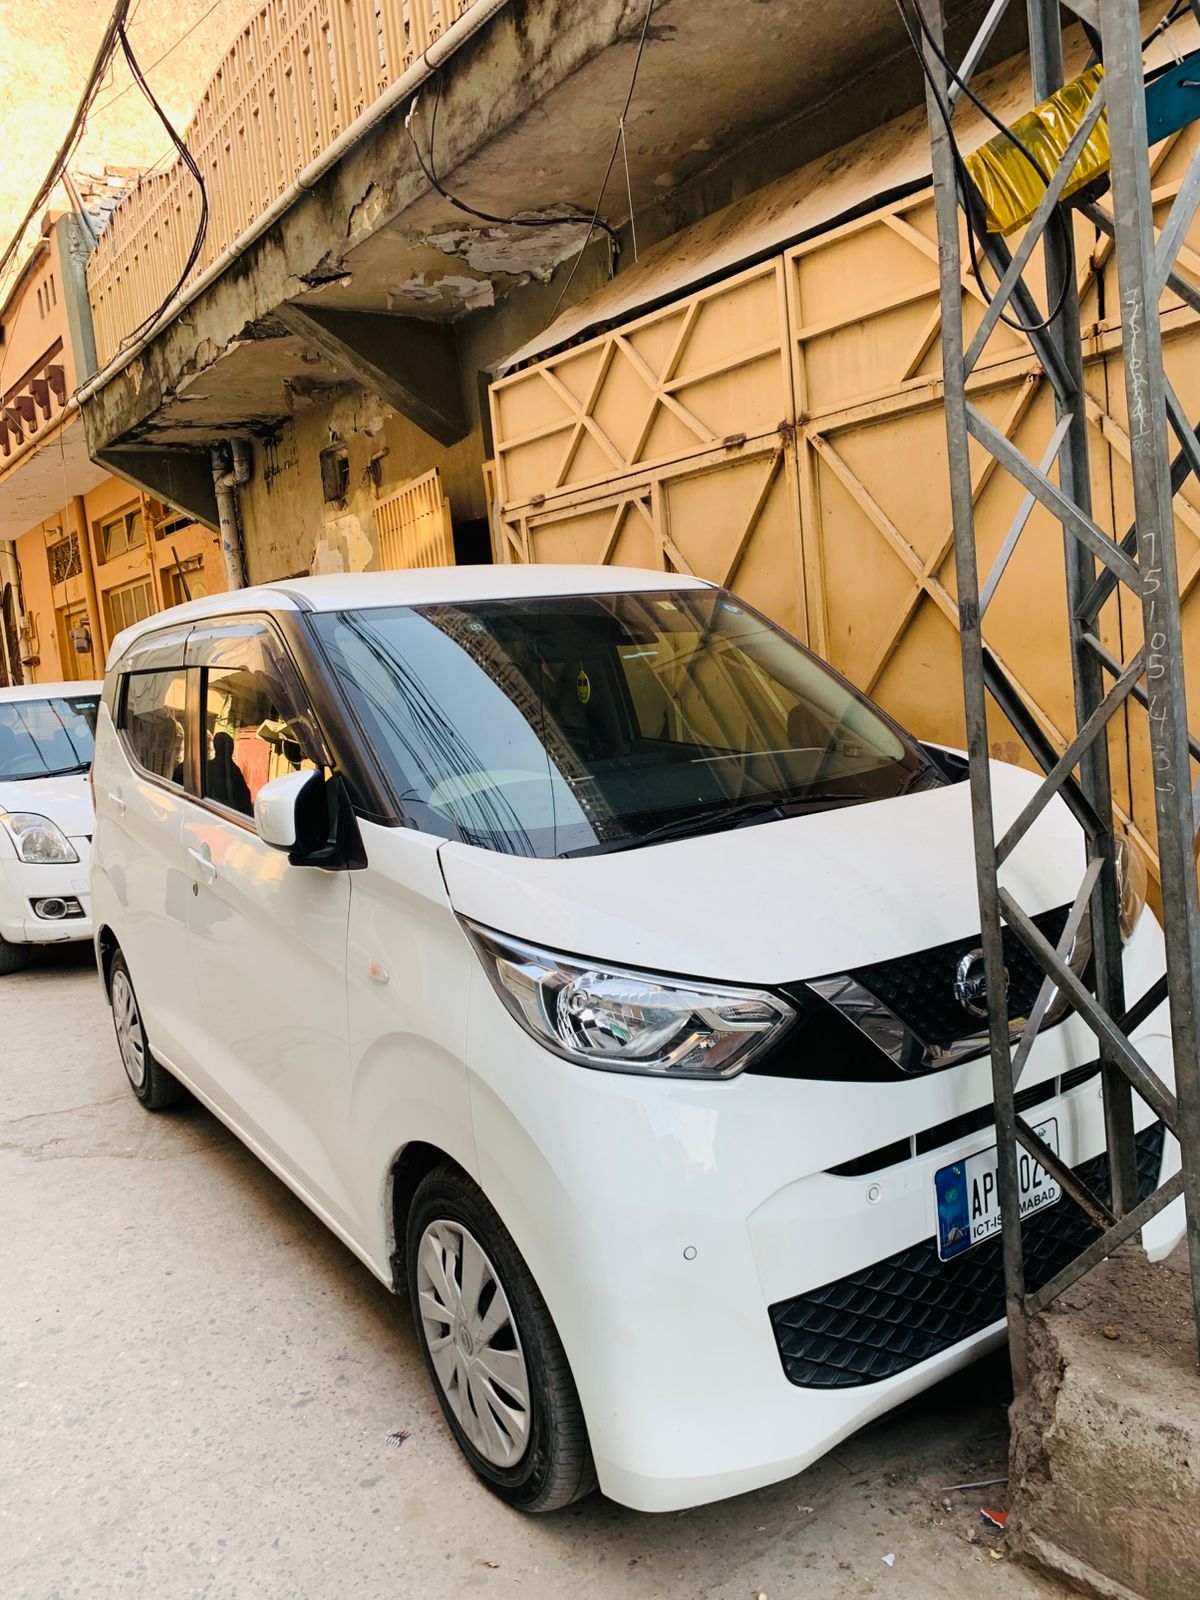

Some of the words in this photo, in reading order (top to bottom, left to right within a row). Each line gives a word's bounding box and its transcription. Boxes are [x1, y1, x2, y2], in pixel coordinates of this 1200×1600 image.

[972, 1168, 1001, 1221] AP
[1020, 1143, 1054, 1194] 02
[973, 1187, 1056, 1238] ICT-ISMABAD
